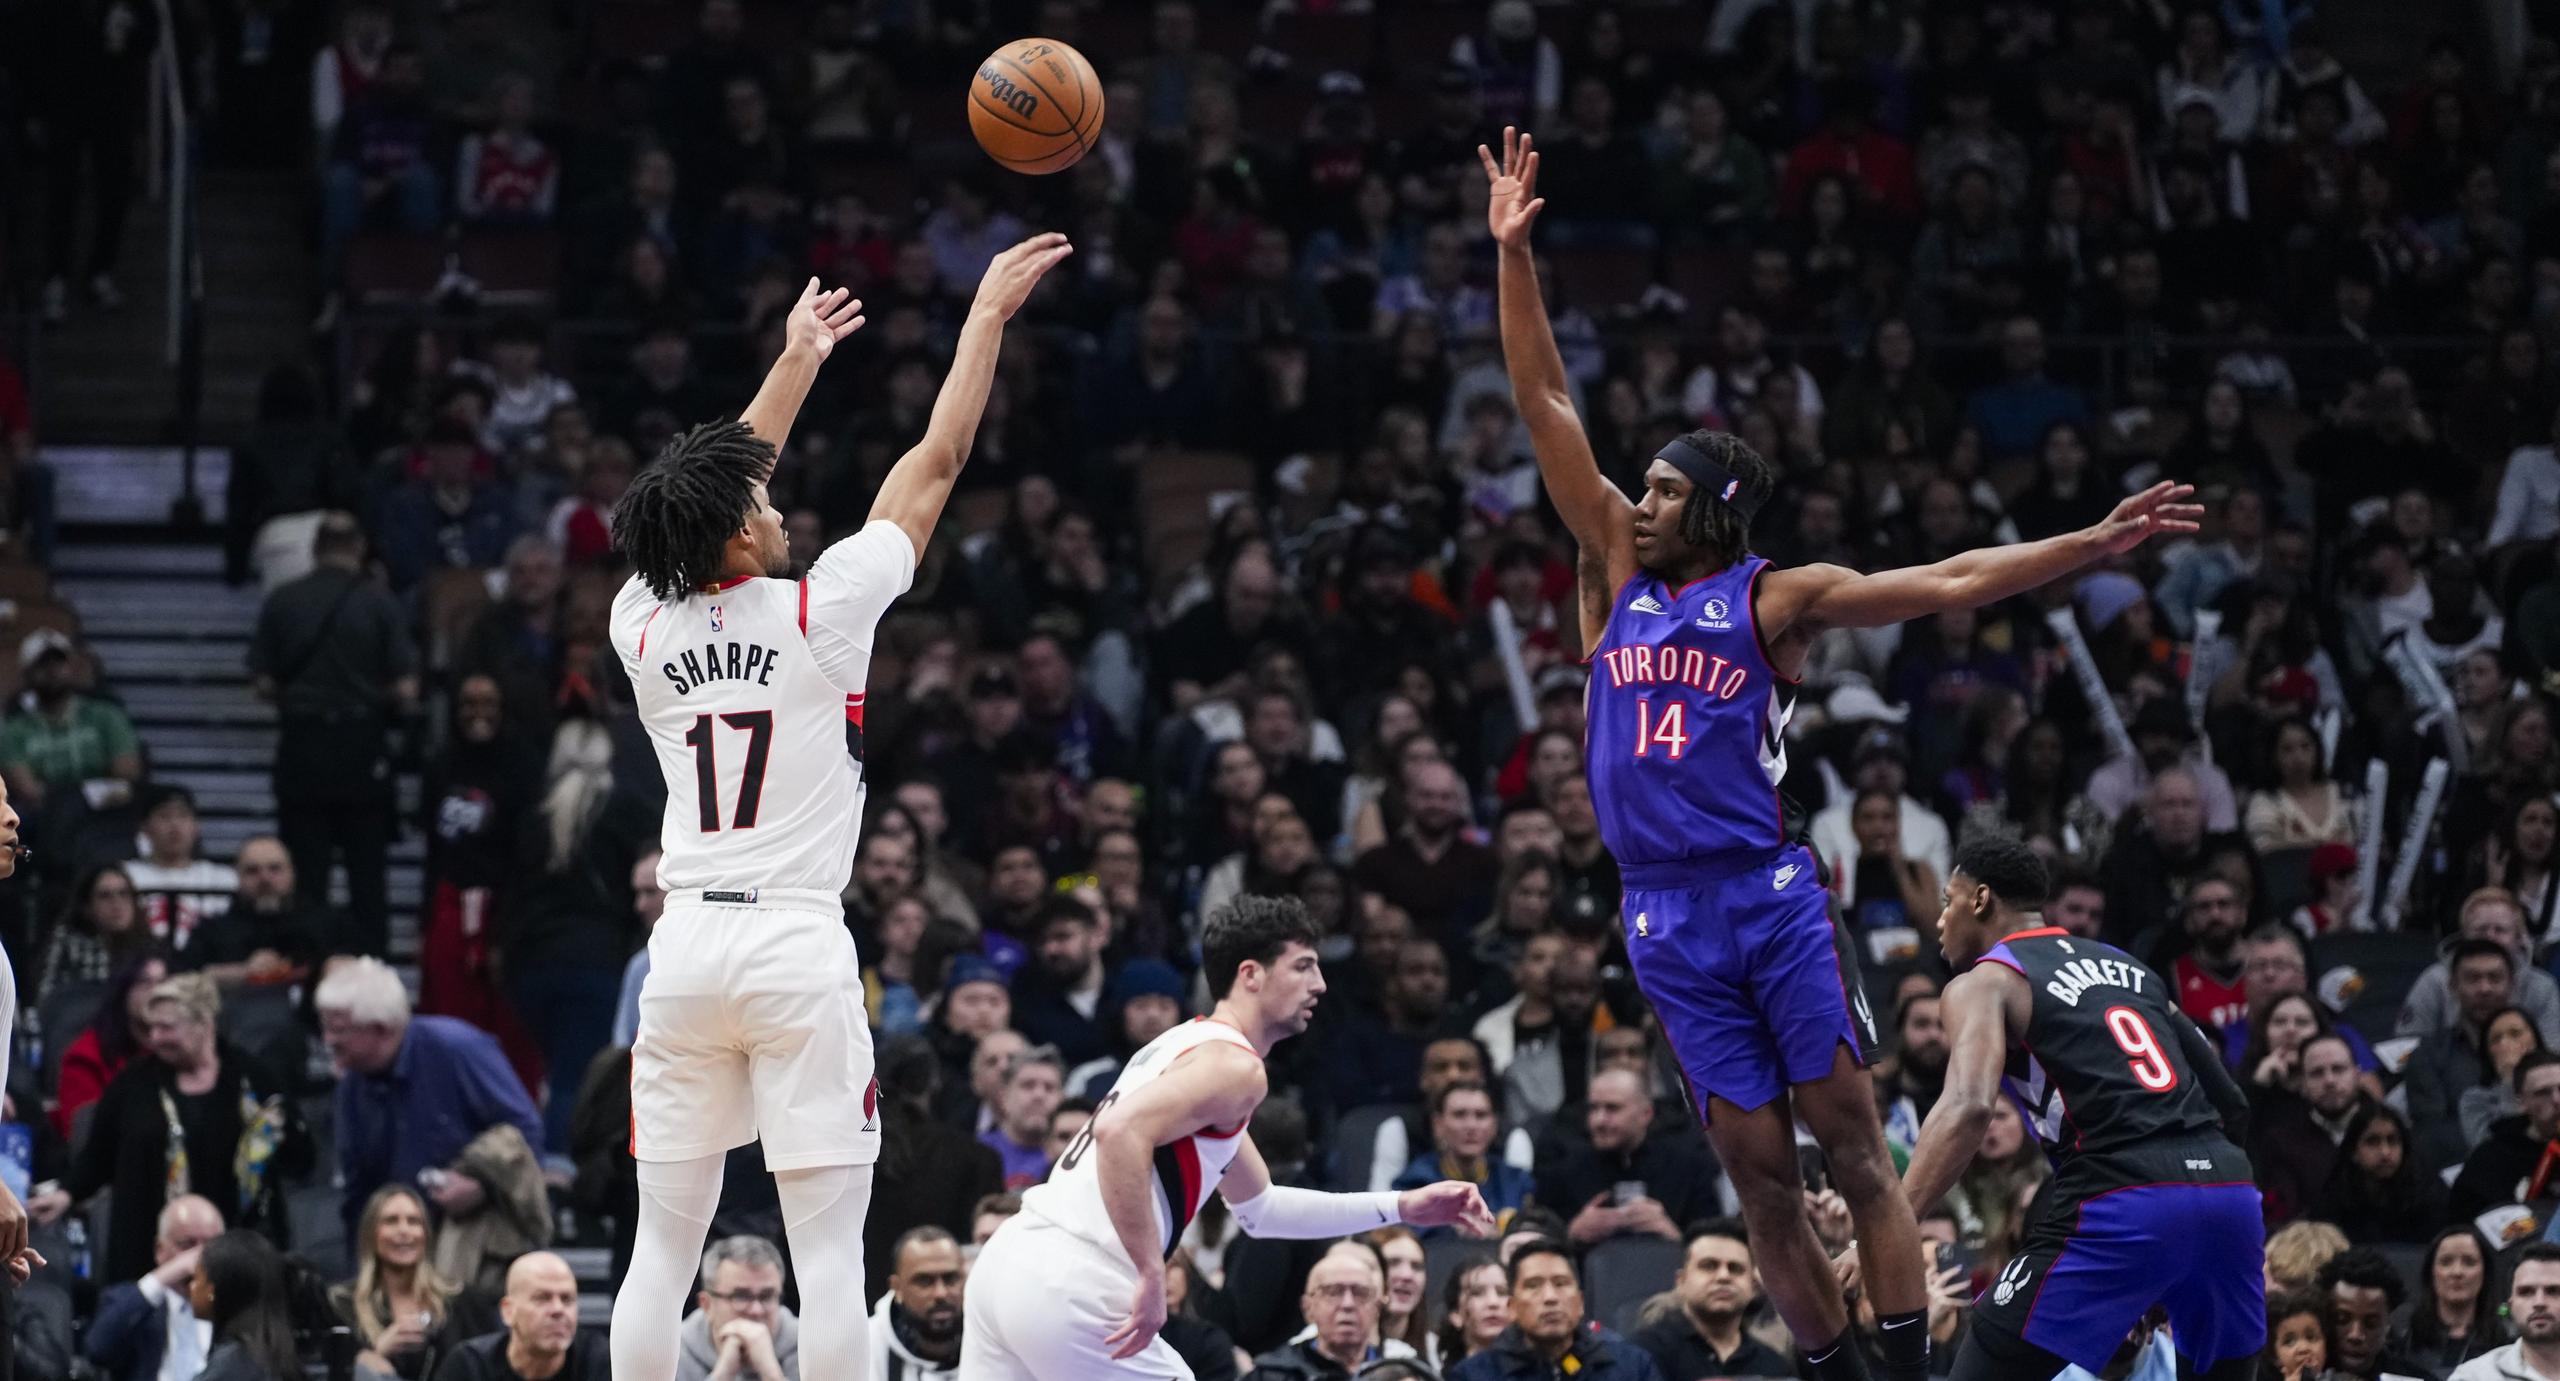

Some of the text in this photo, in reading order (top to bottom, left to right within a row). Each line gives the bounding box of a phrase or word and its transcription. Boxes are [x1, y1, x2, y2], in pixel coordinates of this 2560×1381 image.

[978, 62, 1038, 120] Wilson
[1636, 594, 1663, 610] NIKE
[1695, 618, 1714, 628] Sun
[663, 641, 779, 696] SHARPE
[1603, 643, 1748, 701] TORONTO
[1634, 697, 1690, 762] 14
[685, 709, 773, 833] 17
[2046, 958, 2146, 1007] BARRETT
[2105, 1005, 2179, 1093] 9
